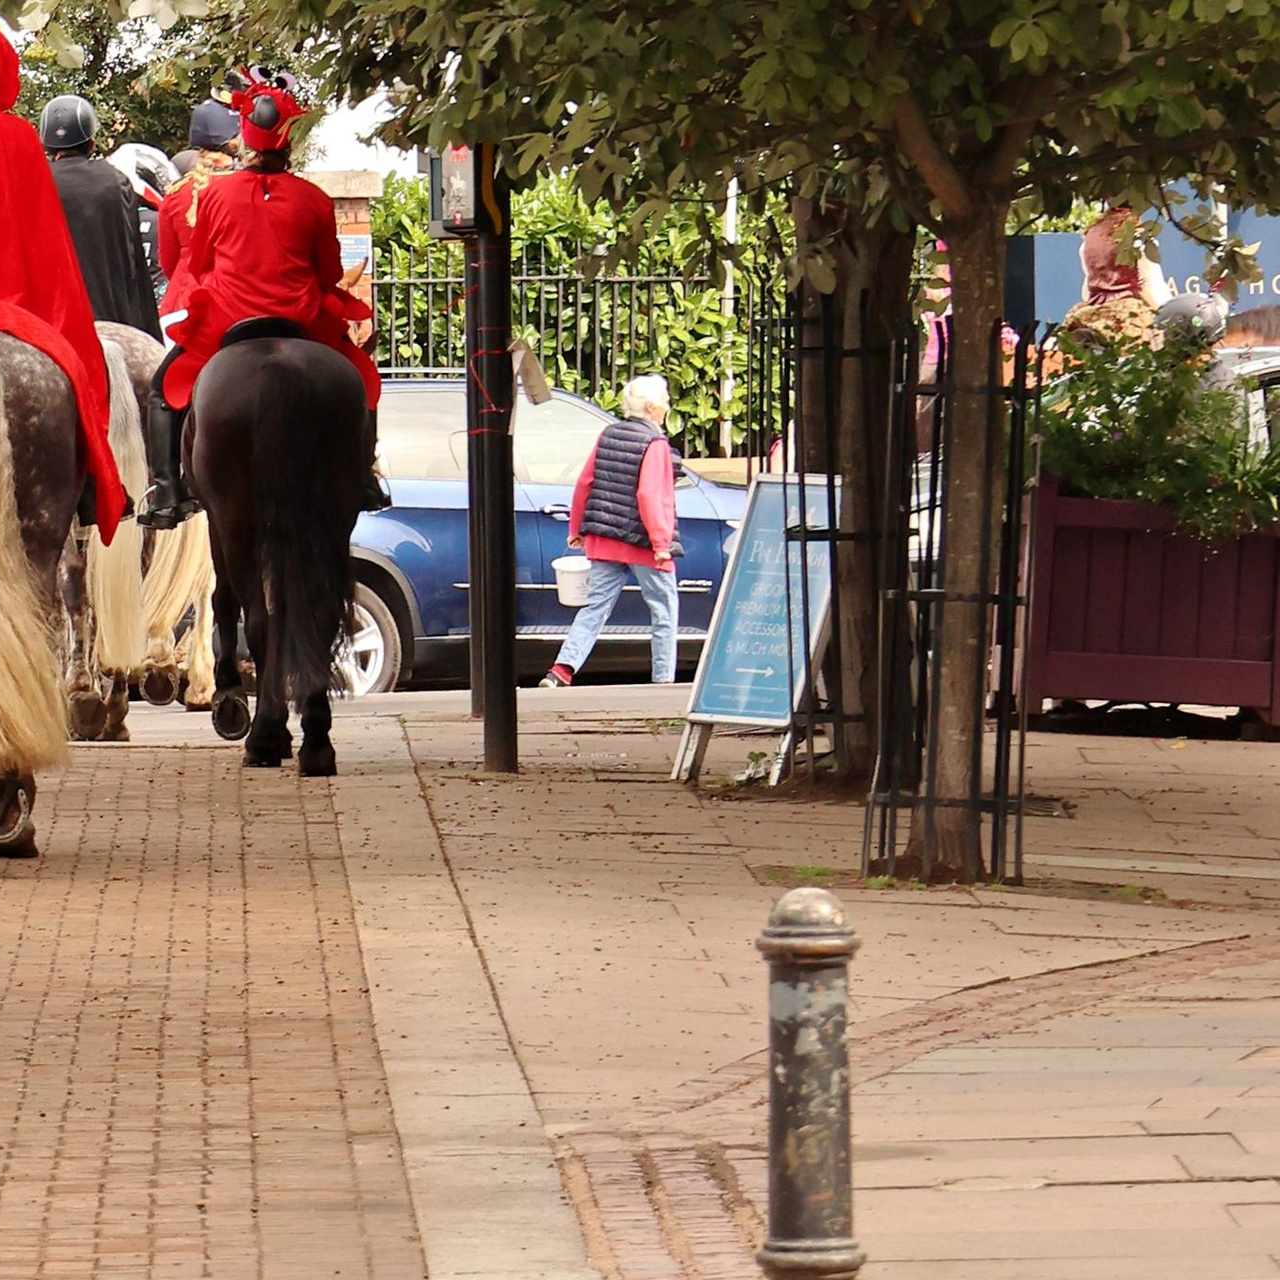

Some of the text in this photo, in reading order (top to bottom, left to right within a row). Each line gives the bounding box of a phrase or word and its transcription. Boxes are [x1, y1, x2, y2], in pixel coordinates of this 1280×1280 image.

[748, 539, 771, 564] Pet
[735, 601, 781, 618] PREMIUM
[735, 621, 801, 638] ACCESSORES
[735, 640, 767, 656] MUCH
